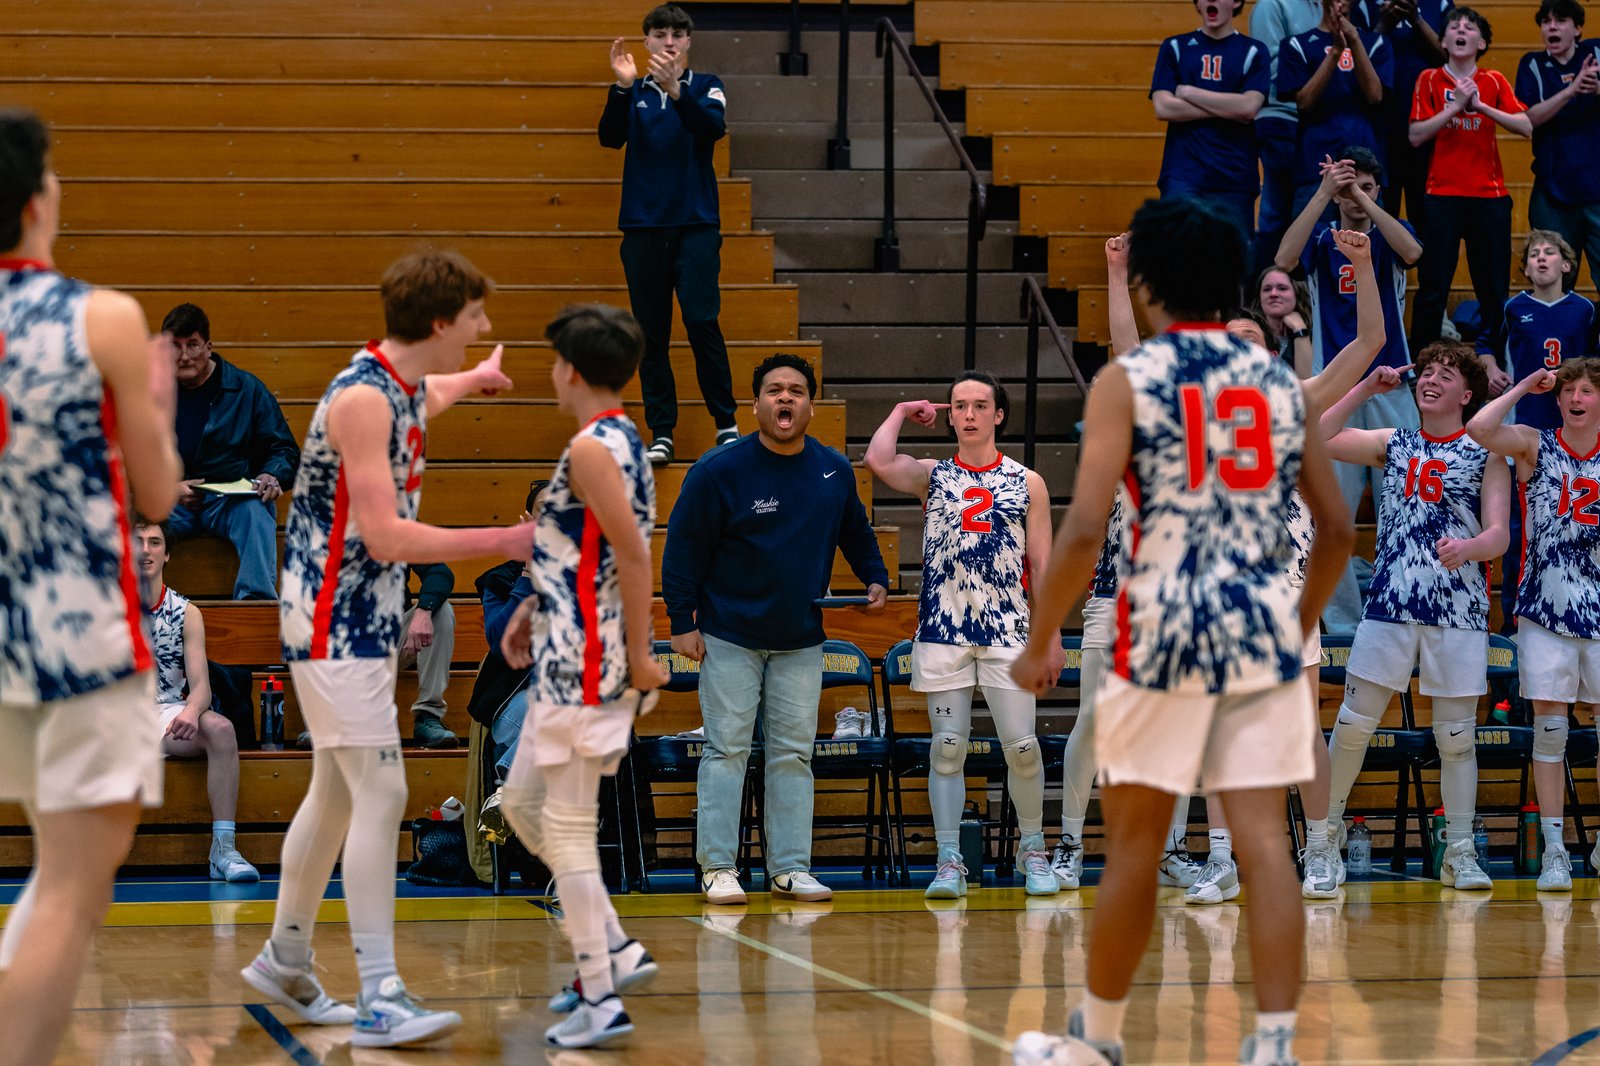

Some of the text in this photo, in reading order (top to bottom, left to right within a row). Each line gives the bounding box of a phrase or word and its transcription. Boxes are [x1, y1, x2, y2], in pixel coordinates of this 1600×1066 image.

[1201, 54, 1222, 81] 11
[1324, 45, 1354, 71] 8
[1339, 264, 1357, 294] 2
[1544, 338, 1561, 368] 3
[1180, 385, 1277, 492] 13
[406, 425, 423, 494] 2
[1404, 457, 1449, 503] 16
[751, 496, 779, 510] Huskie
[961, 486, 994, 534] 2
[1556, 473, 1600, 526] 12
[822, 652, 860, 674] NSHIP
[815, 742, 858, 757] LIONS
[967, 741, 991, 754] ONS
[1368, 733, 1395, 748] ONS
